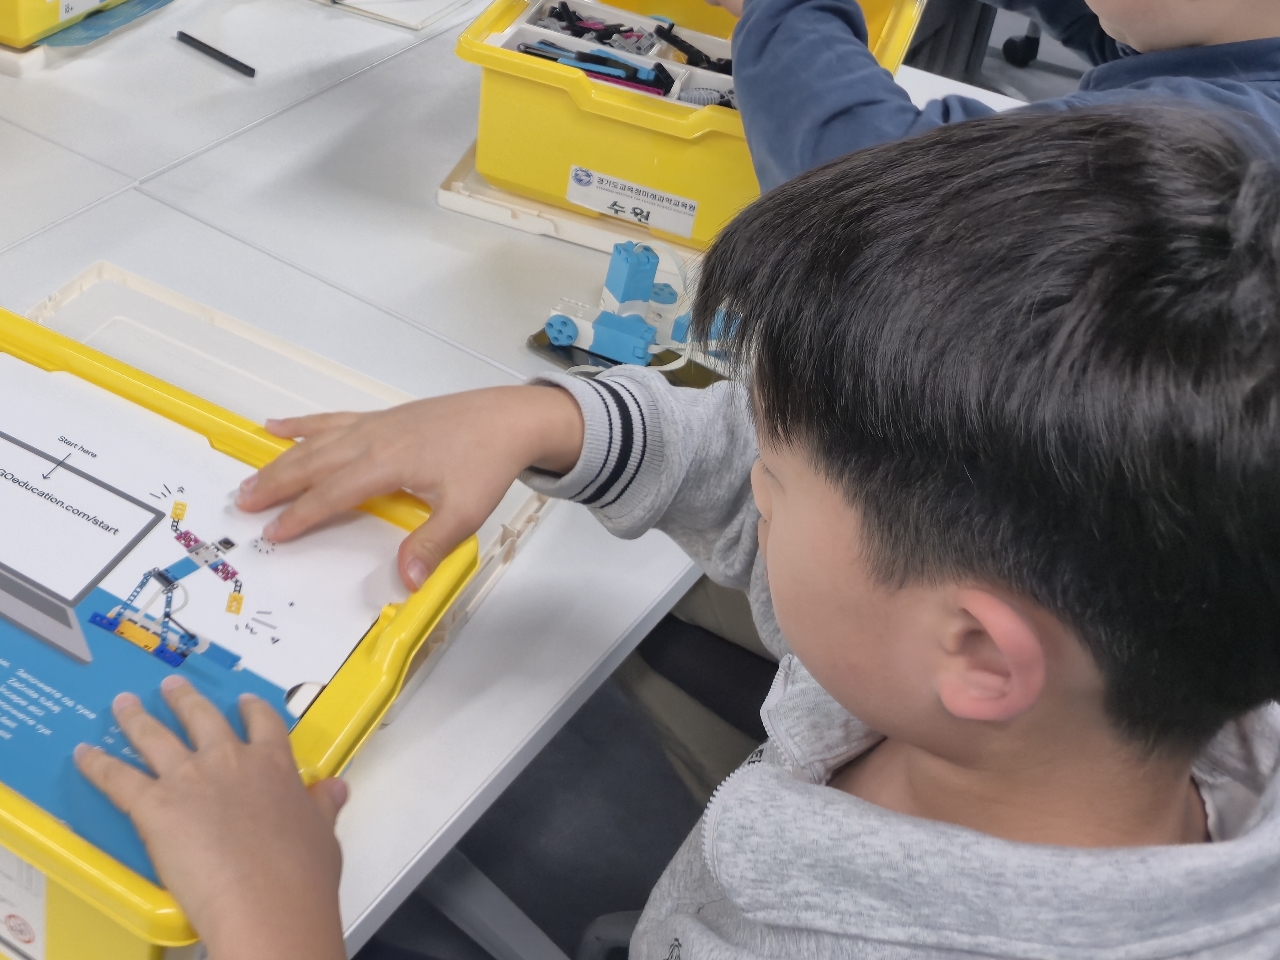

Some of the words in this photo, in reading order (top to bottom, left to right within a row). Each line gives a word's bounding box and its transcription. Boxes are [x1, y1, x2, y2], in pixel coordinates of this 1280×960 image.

[596, 176, 696, 213] 경기도교육청미래과학교육원
[57, 435, 78, 450] Start
[79, 444, 98, 459] here
